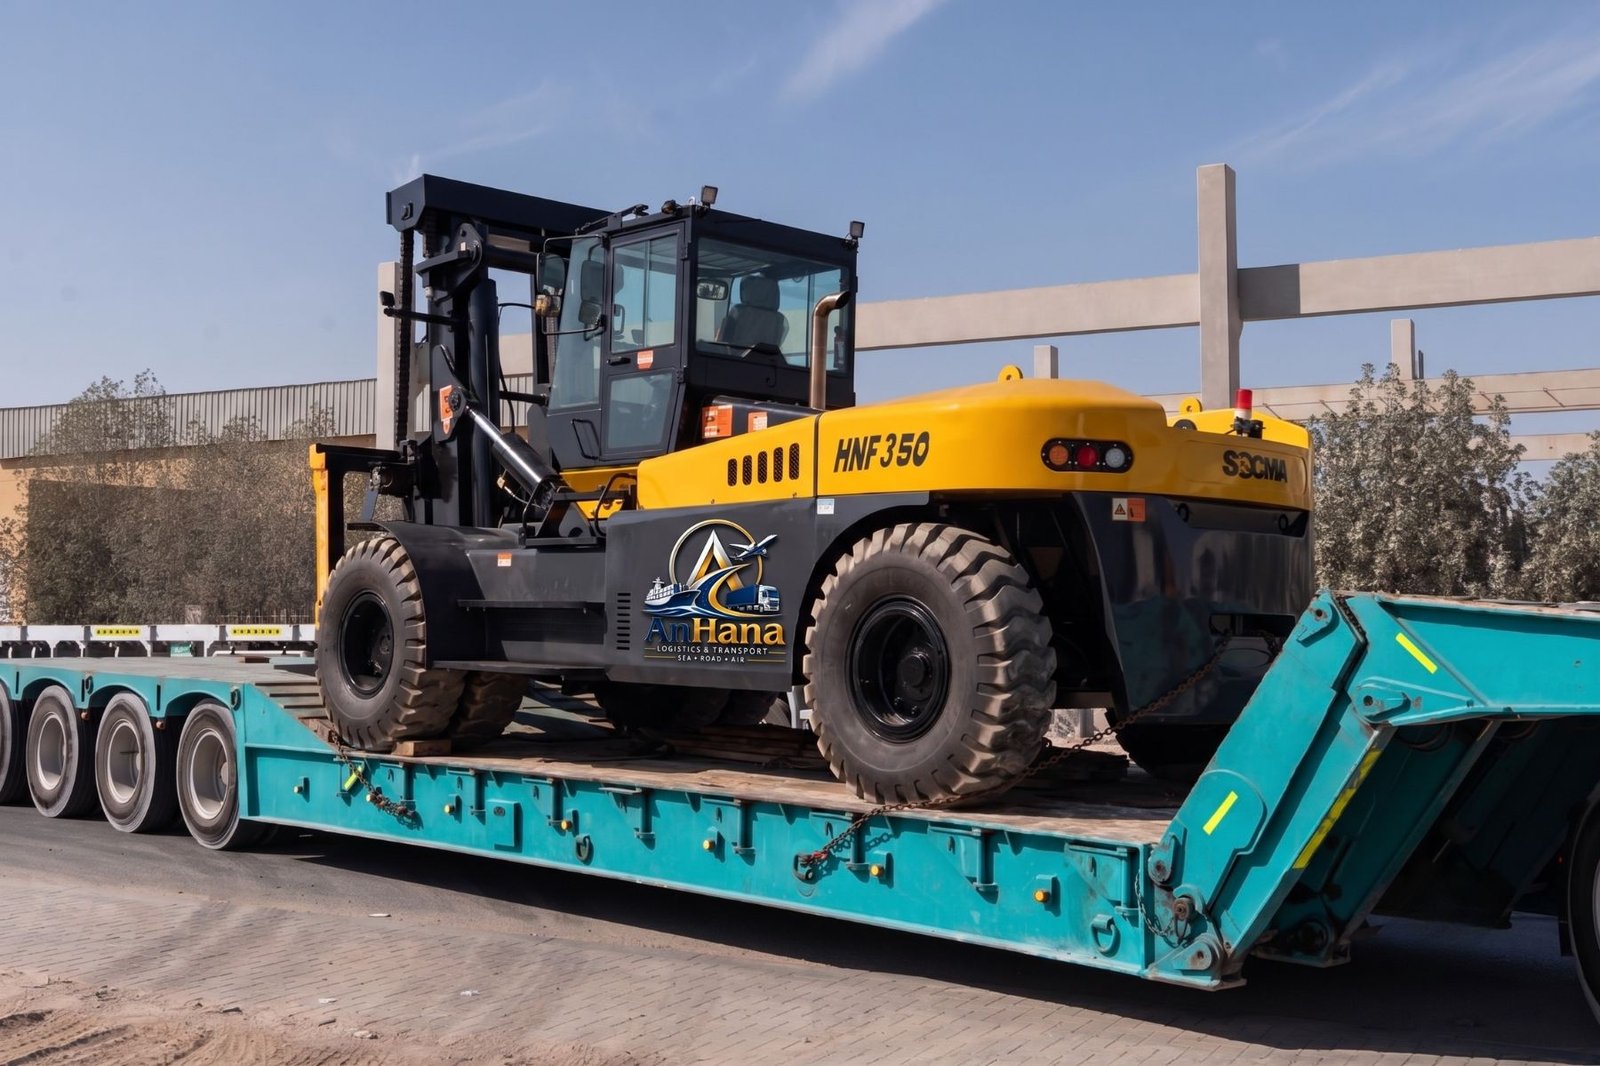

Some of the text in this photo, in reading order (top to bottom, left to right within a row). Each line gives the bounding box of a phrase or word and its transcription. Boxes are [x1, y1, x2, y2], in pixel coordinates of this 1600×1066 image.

[833, 431, 930, 473] HNF350
[1222, 449, 1288, 483] SOCMA
[643, 617, 786, 645] AnHana
[656, 645, 701, 654] LOGISTICS
[713, 646, 768, 656] TRANSPORT
[700, 655, 722, 663] ROAD
[731, 656, 745, 664] AIR
